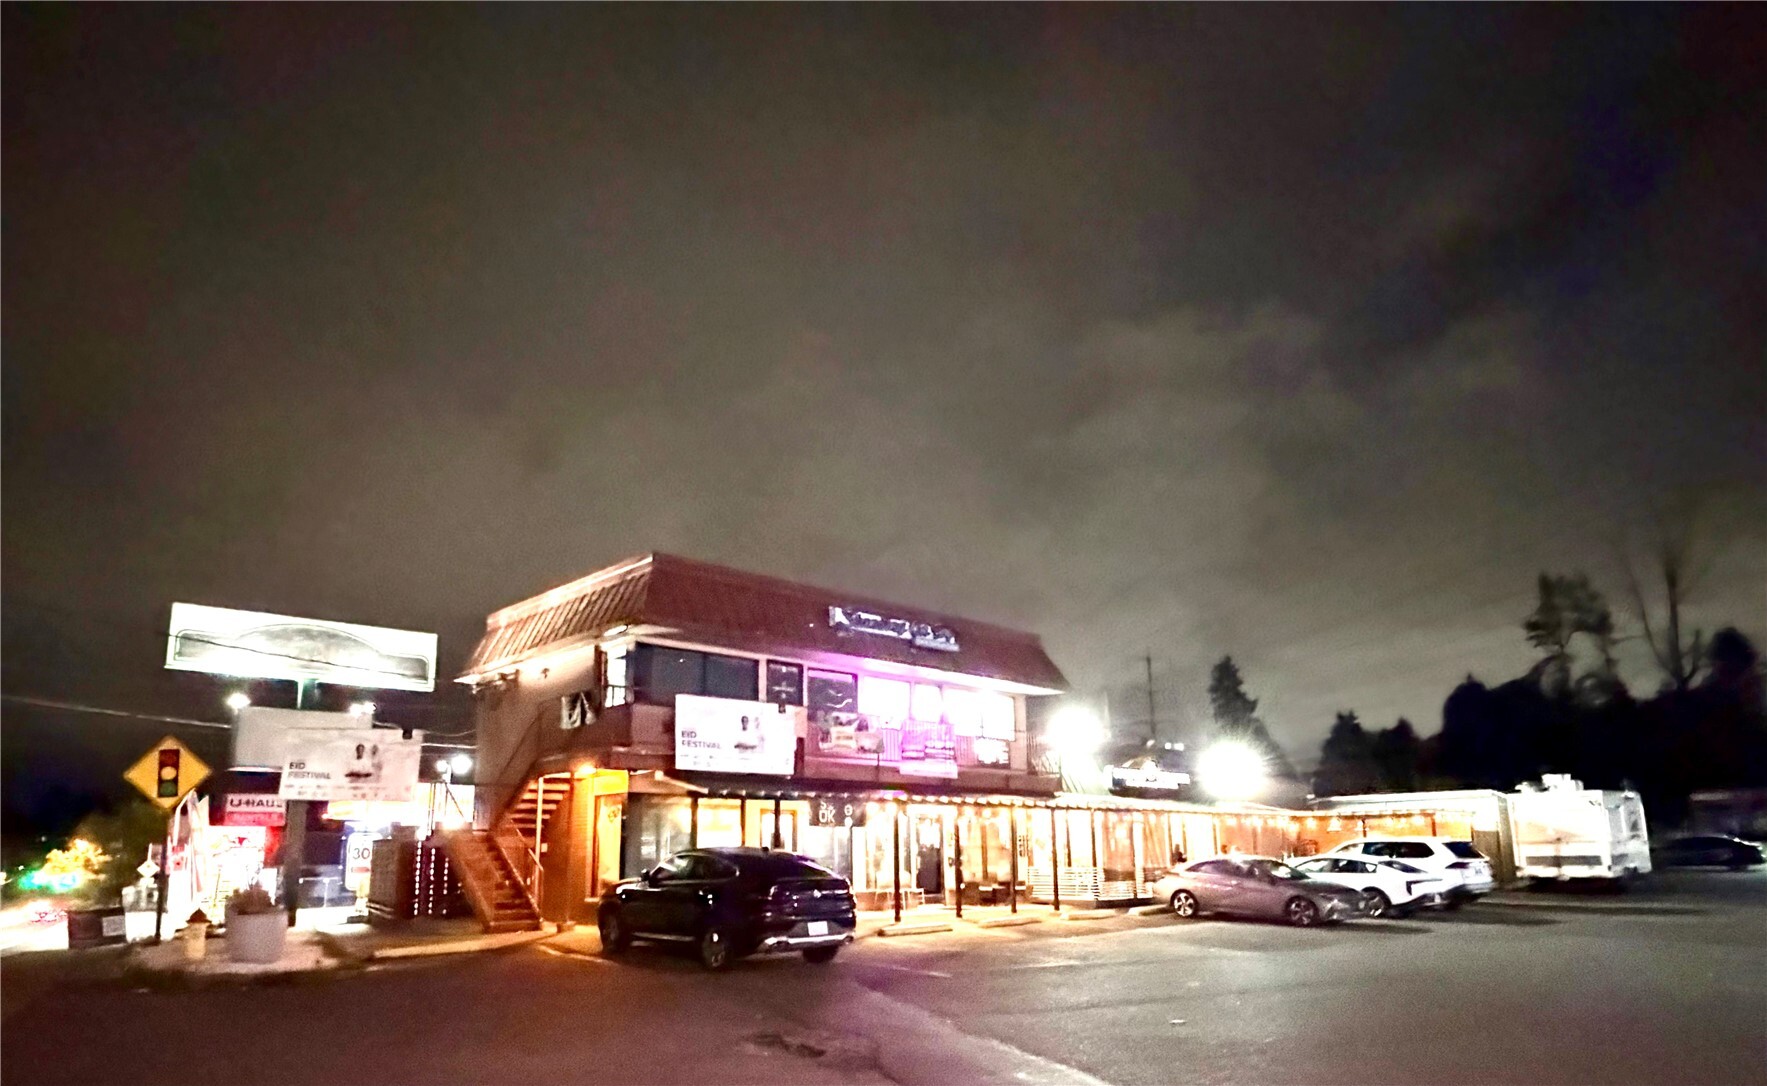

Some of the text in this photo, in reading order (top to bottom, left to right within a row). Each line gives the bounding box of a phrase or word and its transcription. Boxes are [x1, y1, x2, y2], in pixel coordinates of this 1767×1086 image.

[681, 730, 697, 739] EID
[681, 740, 721, 749] FESTIVAL
[289, 762, 306, 770] EID
[288, 771, 331, 780] FESTIVAL
[353, 847, 371, 860] 30
